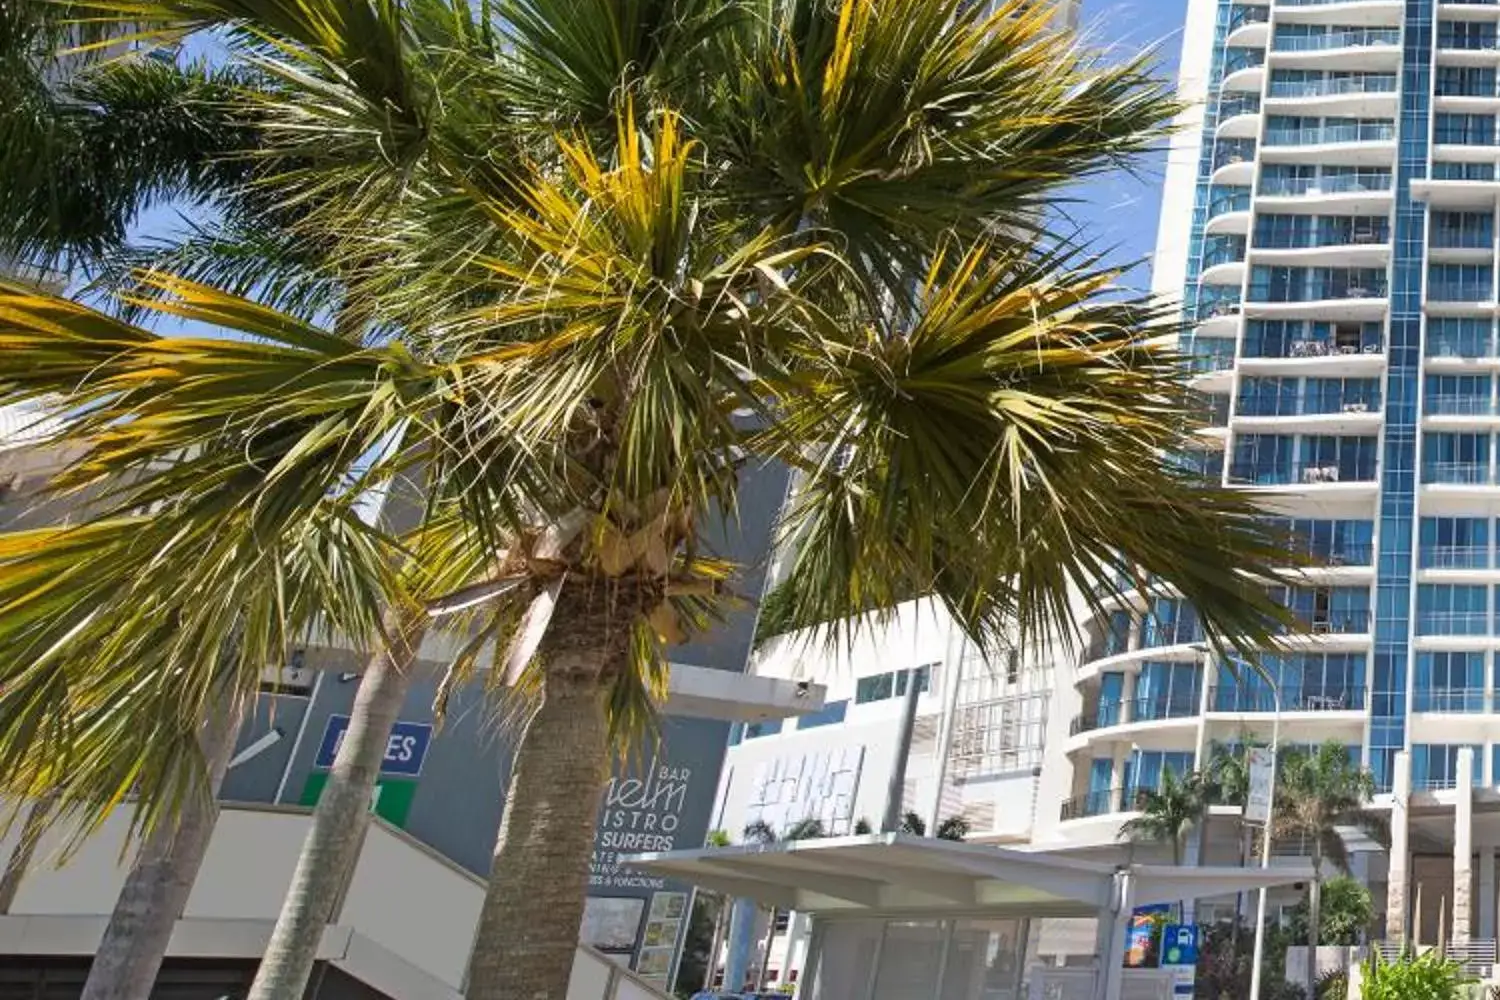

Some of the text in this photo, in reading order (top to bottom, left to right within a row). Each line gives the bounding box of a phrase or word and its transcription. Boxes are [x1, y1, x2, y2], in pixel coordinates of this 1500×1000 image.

[659, 765, 691, 781] BAR
[603, 809, 678, 832] ISTRO
[601, 831, 674, 852] SURFERS
